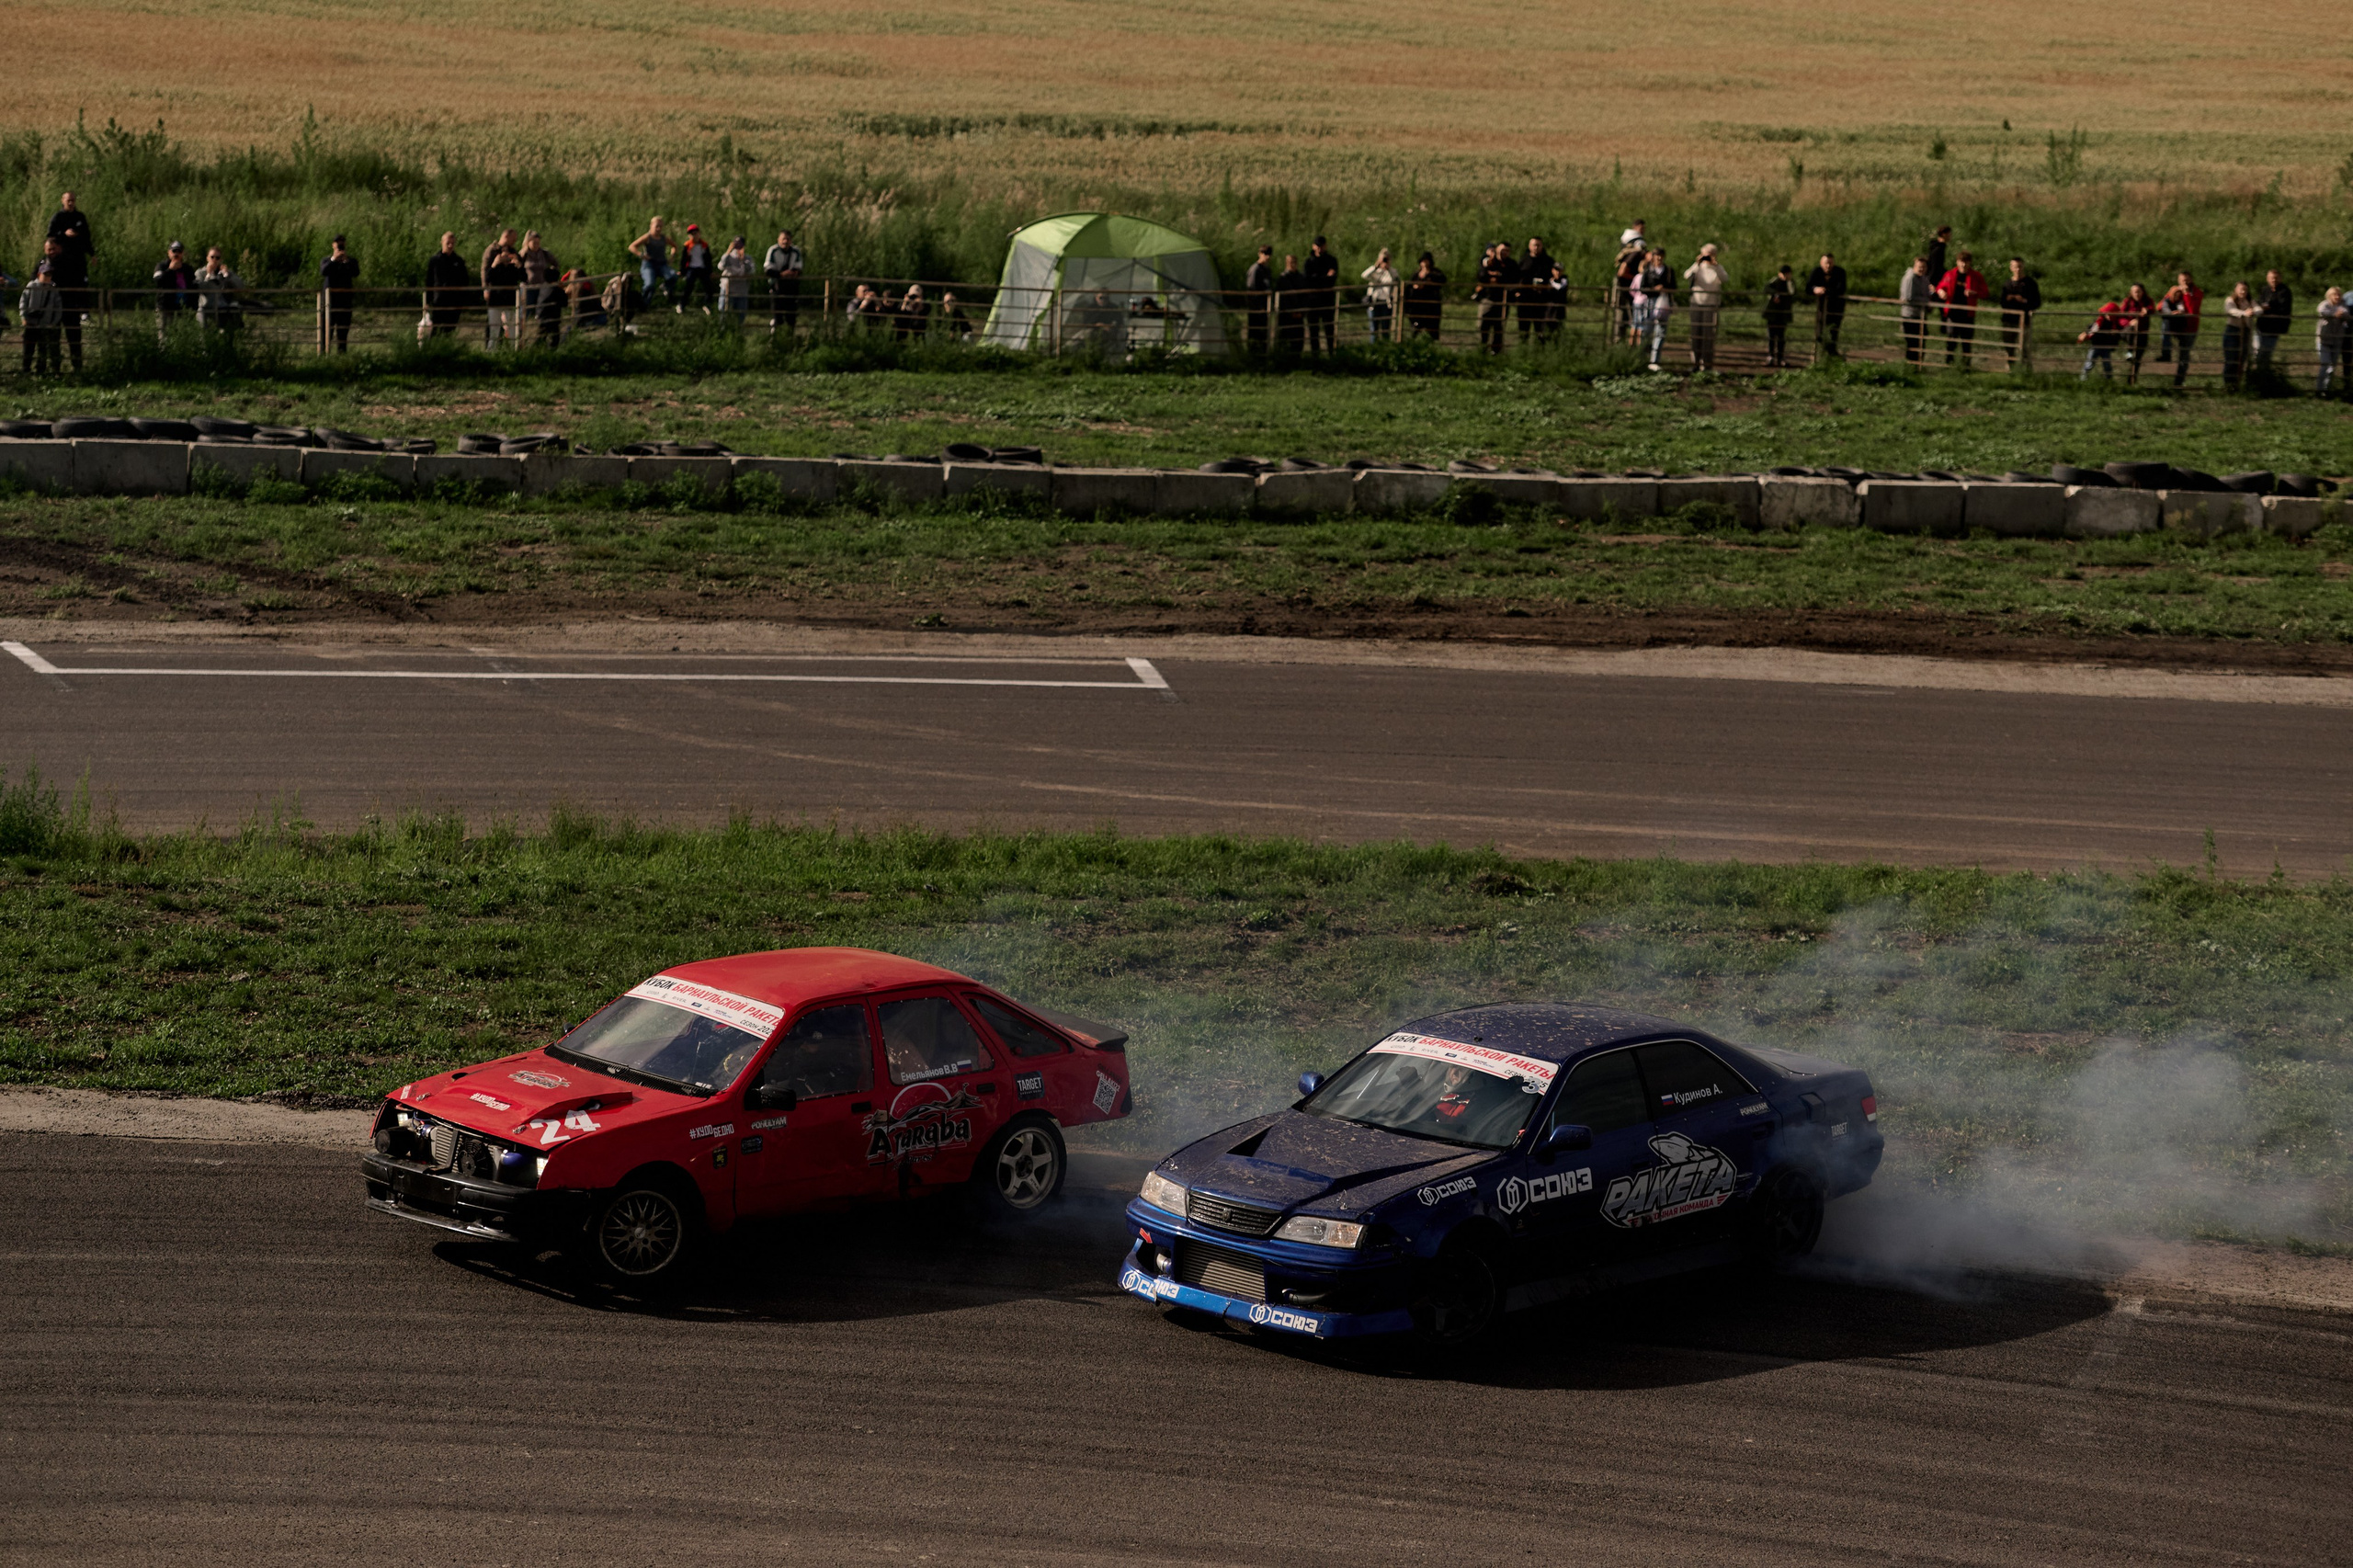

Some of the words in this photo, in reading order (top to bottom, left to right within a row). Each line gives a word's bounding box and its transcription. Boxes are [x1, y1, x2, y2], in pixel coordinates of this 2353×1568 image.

[643, 976, 677, 990] КУБОК
[672, 983, 749, 1012] БАРНАУЛЬСКОЙ
[739, 1018, 758, 1029] СЕЗОН
[1385, 1034, 1419, 1043] КУБОК
[1418, 1037, 1509, 1062] БАРНАУЛЬСКОЙ
[1506, 1057, 1556, 1080] РАКЕТЫ
[1017, 1076, 1043, 1092] TARGET
[1674, 1086, 1712, 1106] Кудинов
[1713, 1083, 1723, 1096] А.
[529, 1109, 601, 1145] 24
[1436, 1176, 1478, 1199] СОЮЗ
[1528, 1166, 1594, 1204] СОЮЗ
[1601, 1156, 1735, 1221] РАКЕТА
[1679, 1199, 1713, 1213] КОМАНДА
[1270, 1310, 1319, 1334] СОЮЗ
